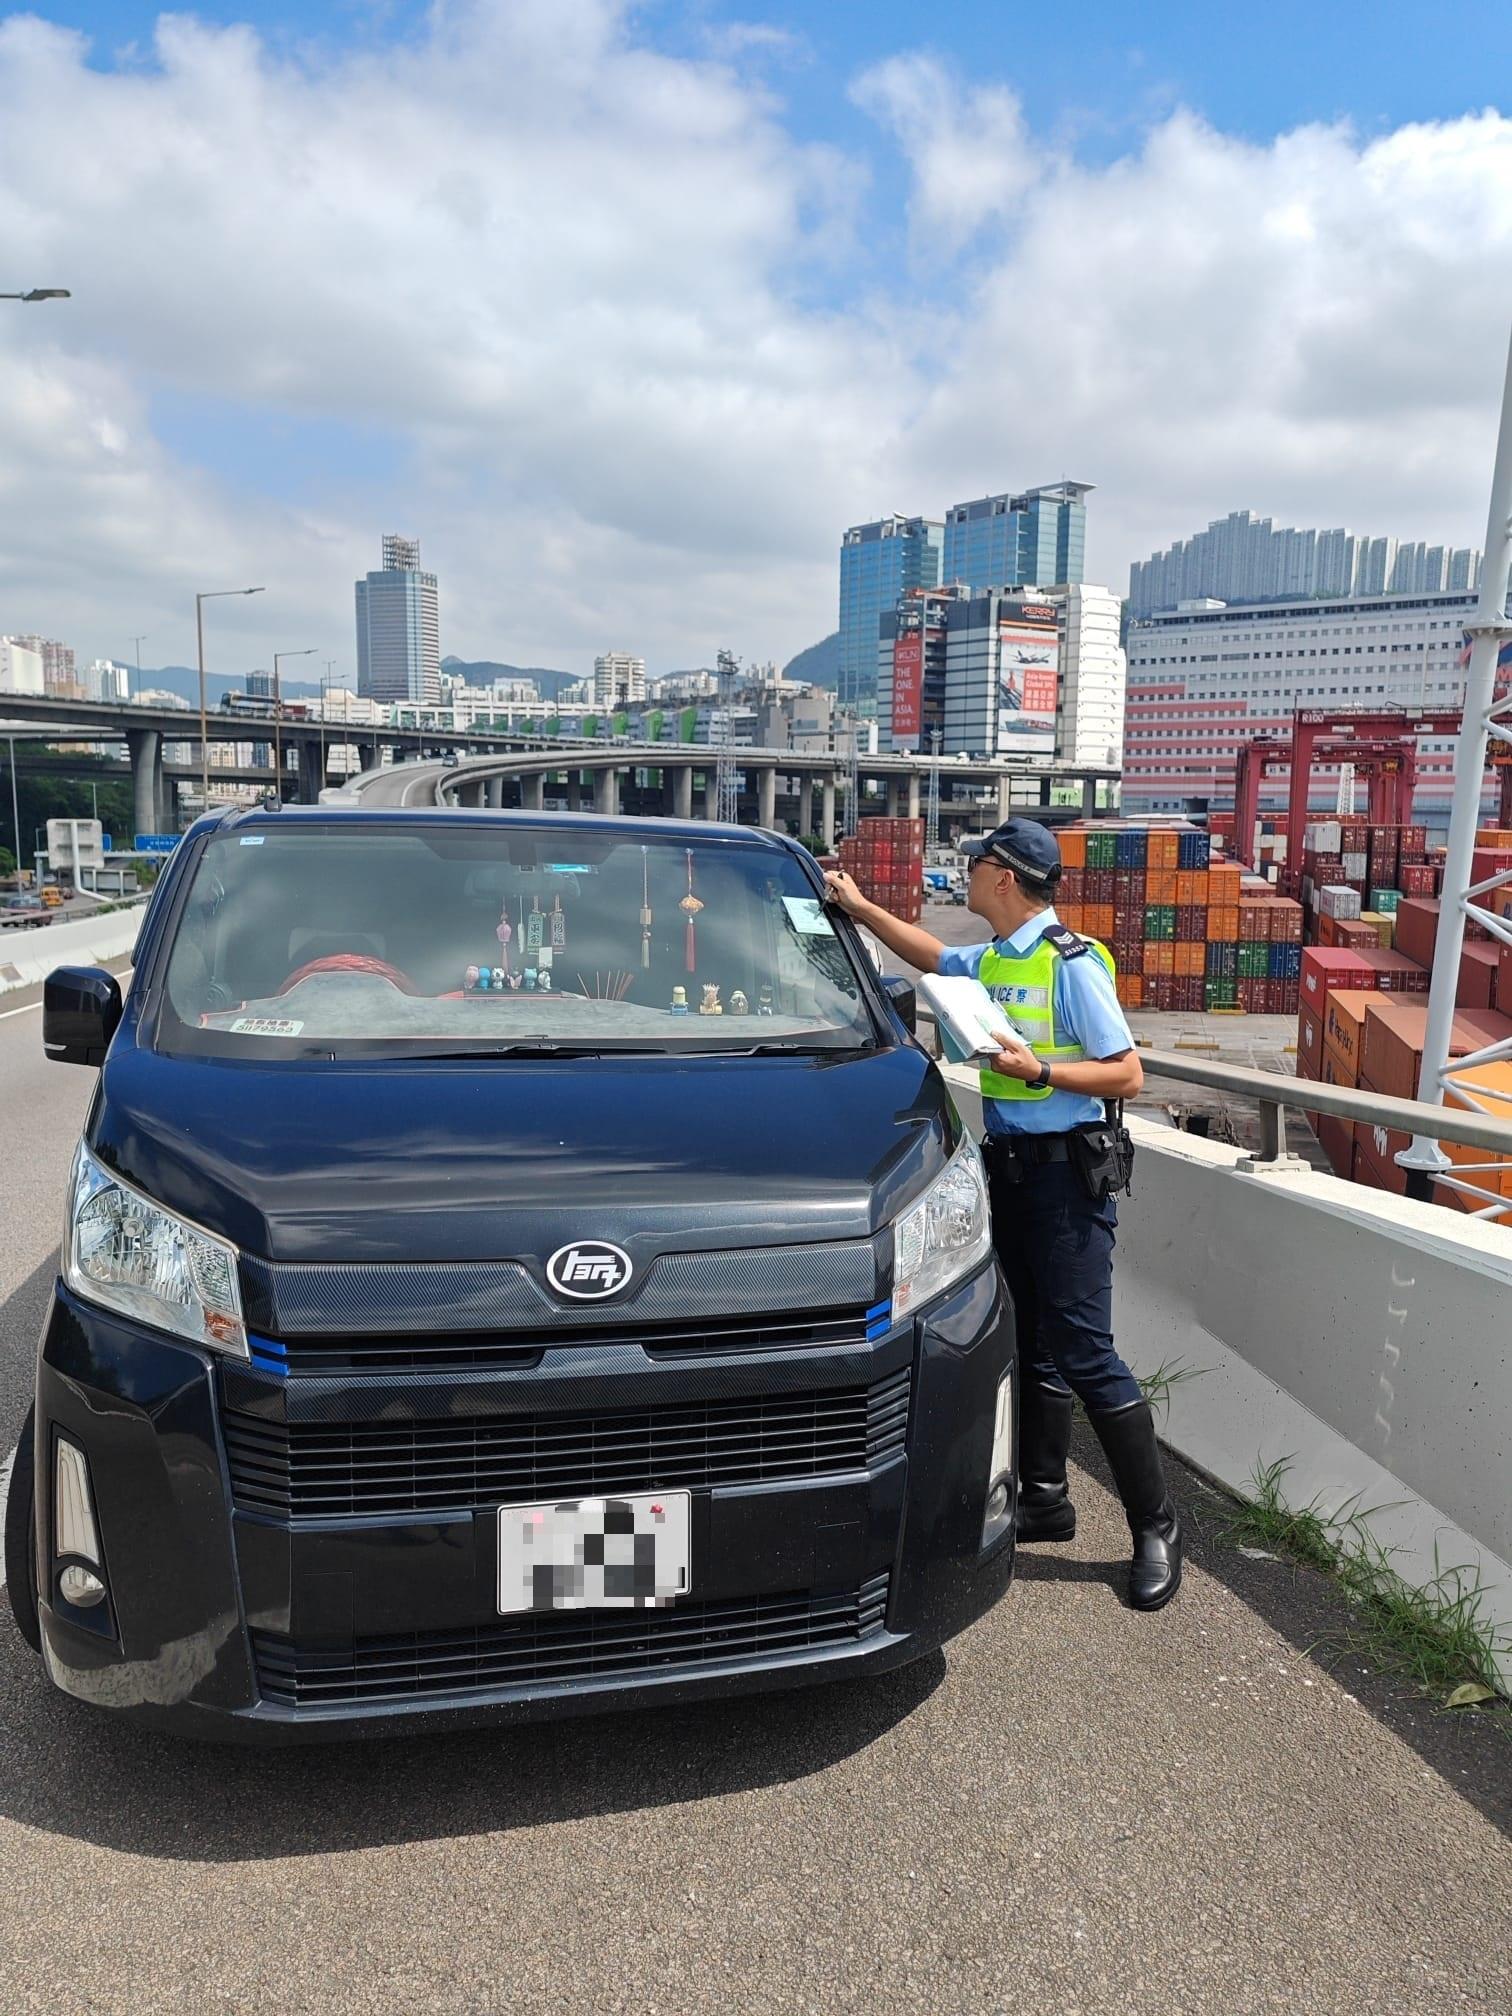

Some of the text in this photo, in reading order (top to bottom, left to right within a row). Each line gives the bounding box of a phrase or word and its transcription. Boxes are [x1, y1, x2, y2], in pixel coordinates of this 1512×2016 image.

[896, 667, 911, 678] THE
[896, 692, 905, 702] IN
[1016, 988, 1027, 1003] 察
